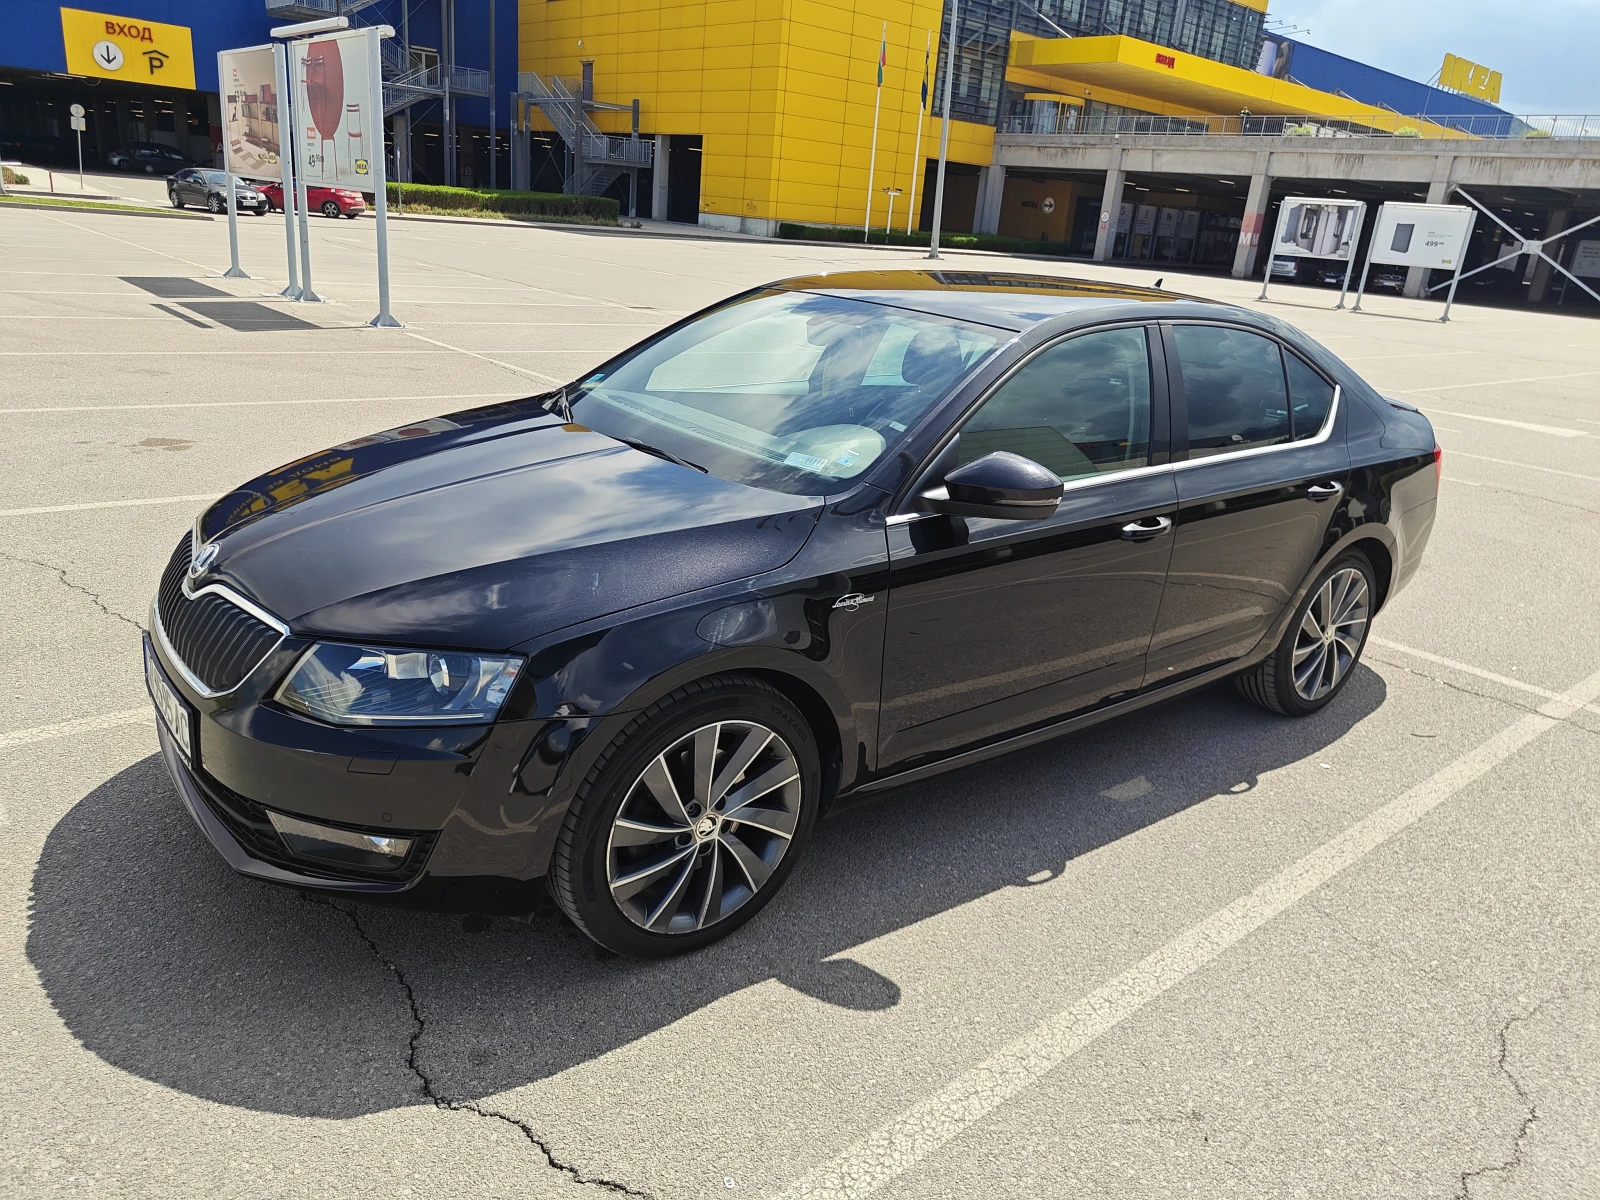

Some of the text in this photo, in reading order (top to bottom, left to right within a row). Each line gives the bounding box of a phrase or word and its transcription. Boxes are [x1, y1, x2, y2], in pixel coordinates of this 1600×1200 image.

[104, 21, 154, 43] ВХОД
[148, 56, 164, 75] P
[1438, 52, 1503, 104] IKEA
[770, 705, 807, 742] TRAZANO
